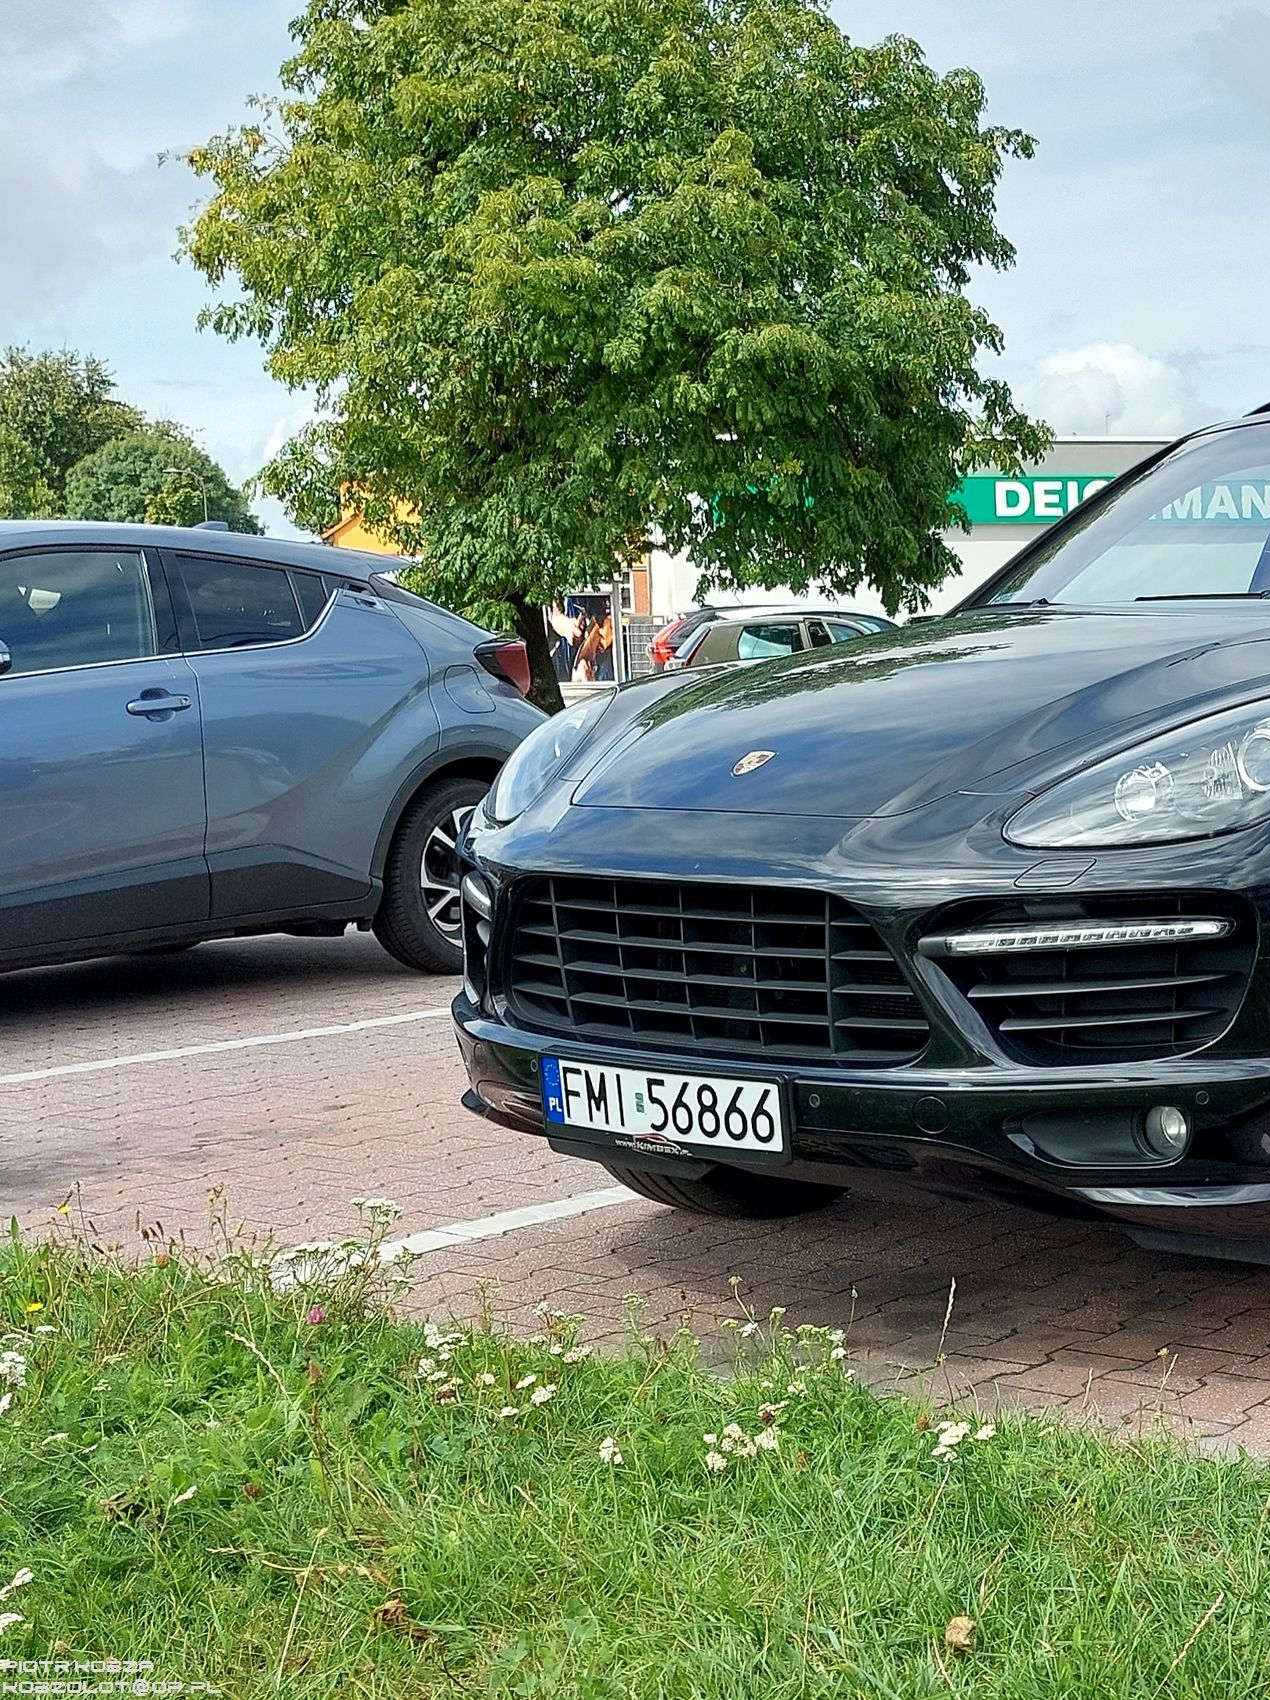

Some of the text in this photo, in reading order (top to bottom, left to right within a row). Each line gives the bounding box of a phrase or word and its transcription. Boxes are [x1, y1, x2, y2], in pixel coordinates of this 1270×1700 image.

[549, 1096, 563, 1113] PL
[562, 1066, 775, 1144] FMI 56866
